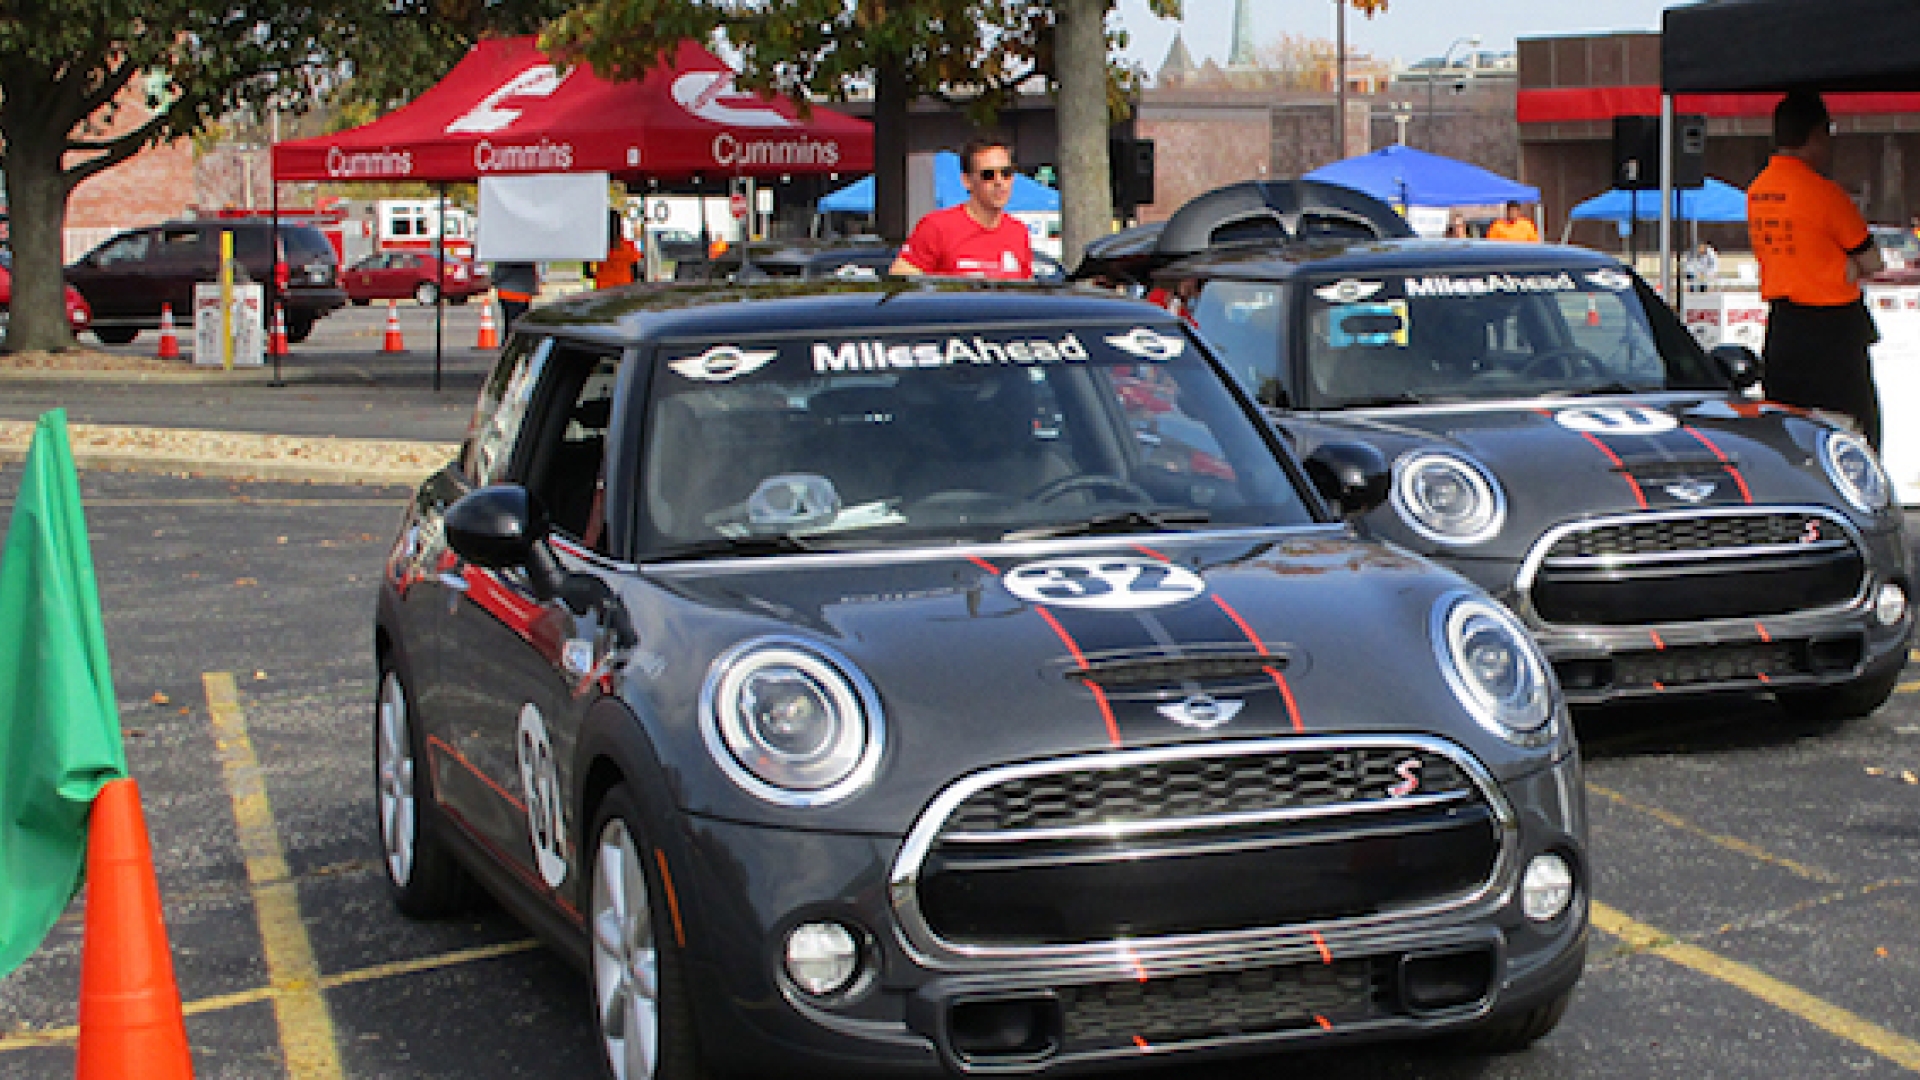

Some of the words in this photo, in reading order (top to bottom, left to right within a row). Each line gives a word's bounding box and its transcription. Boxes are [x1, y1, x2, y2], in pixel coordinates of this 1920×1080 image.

[327, 143, 413, 177] Cummins
[475, 138, 573, 170] Cummins
[713, 132, 839, 167] Cummins
[812, 331, 1090, 372] MilesAhead
[1799, 519, 1820, 544] S
[1018, 562, 1196, 599] 32
[1387, 760, 1422, 797] S
